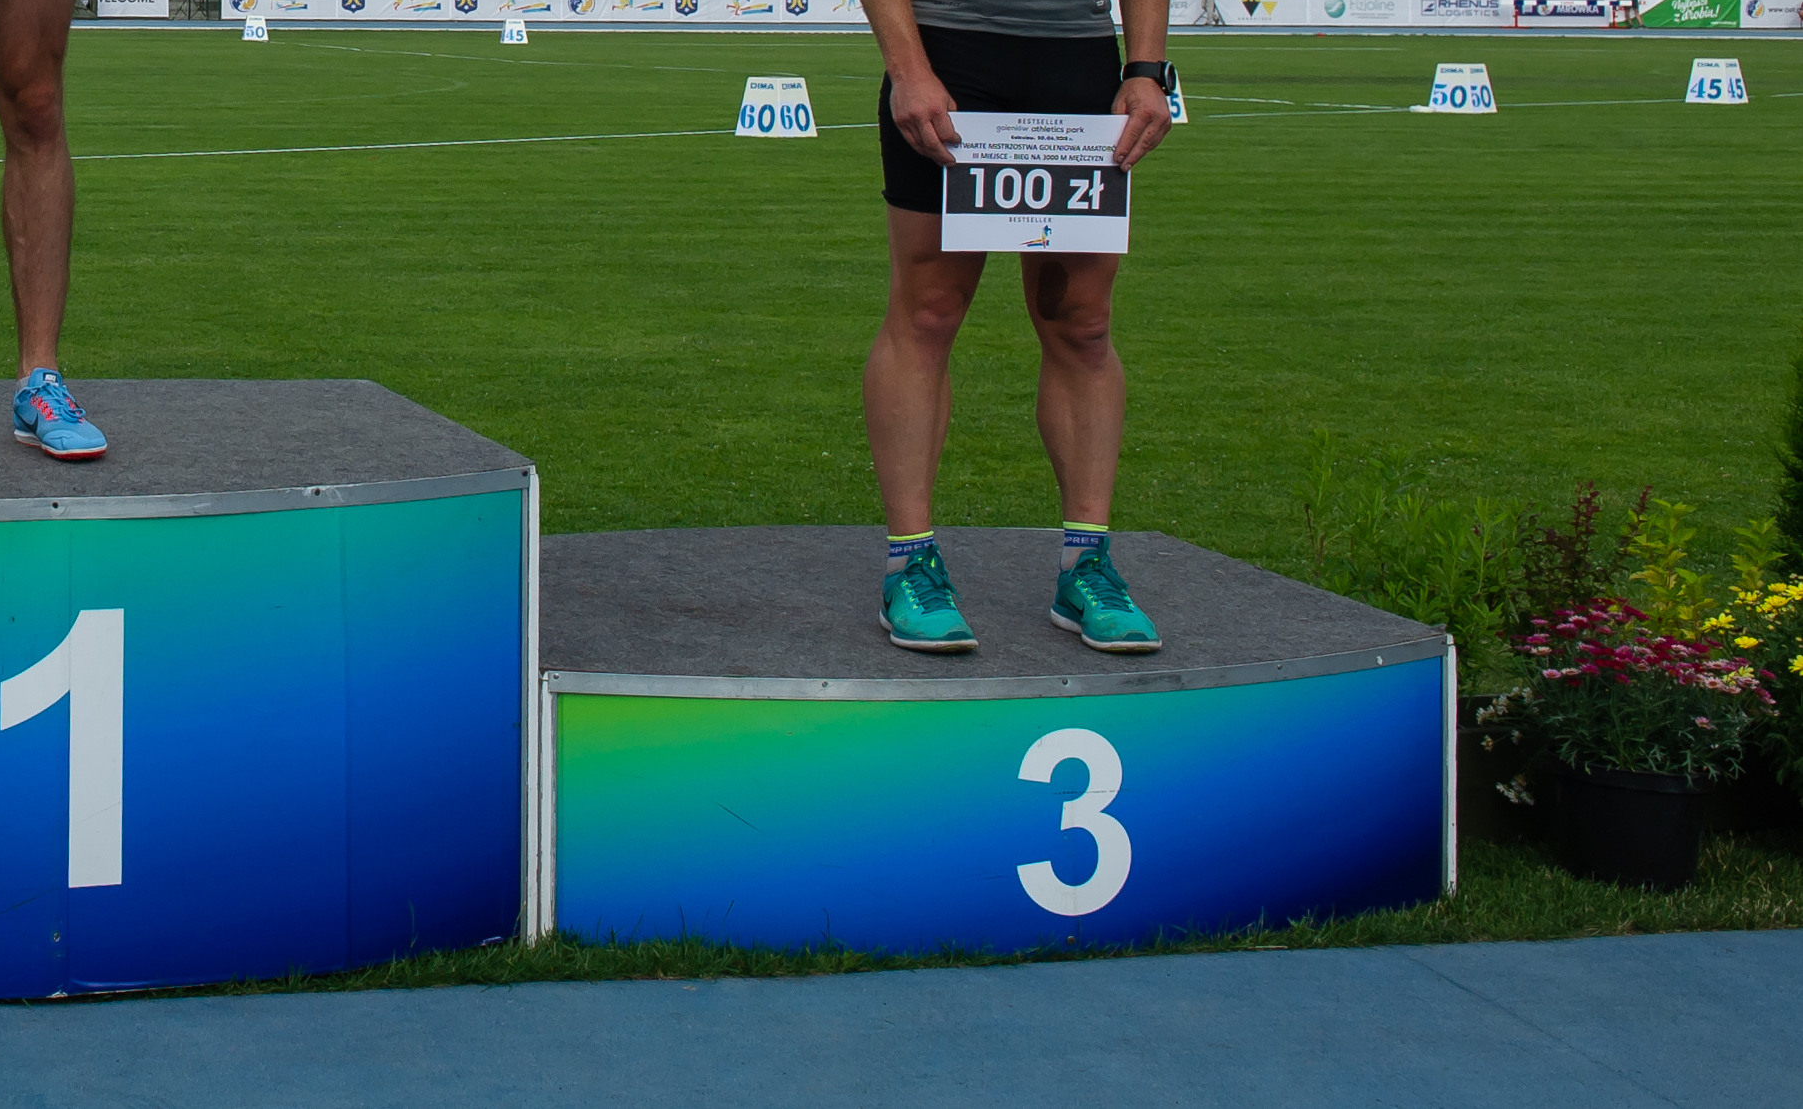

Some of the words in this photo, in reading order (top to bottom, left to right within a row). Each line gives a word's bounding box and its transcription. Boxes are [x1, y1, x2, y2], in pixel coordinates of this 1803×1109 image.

[1438, 0, 1500, 9] RHENUS
[1438, 9, 1500, 17] LOGISTICS
[245, 25, 265, 38] 50
[506, 29, 524, 41] 45
[1432, 84, 1467, 108] 50
[1470, 84, 1491, 108] 50
[1690, 77, 1722, 100] 45
[1728, 77, 1744, 99] 45
[1170, 93, 1181, 118] 5
[740, 104, 775, 133] 60
[780, 103, 811, 132] 60
[1031, 125, 1064, 133] athletics
[1066, 126, 1085, 134] park
[1069, 153, 1104, 162] MĘŻCZYZN
[970, 168, 1052, 209] 100
[1067, 170, 1105, 210] zł
[0, 607, 124, 888] 1
[1017, 728, 1132, 916] 3
